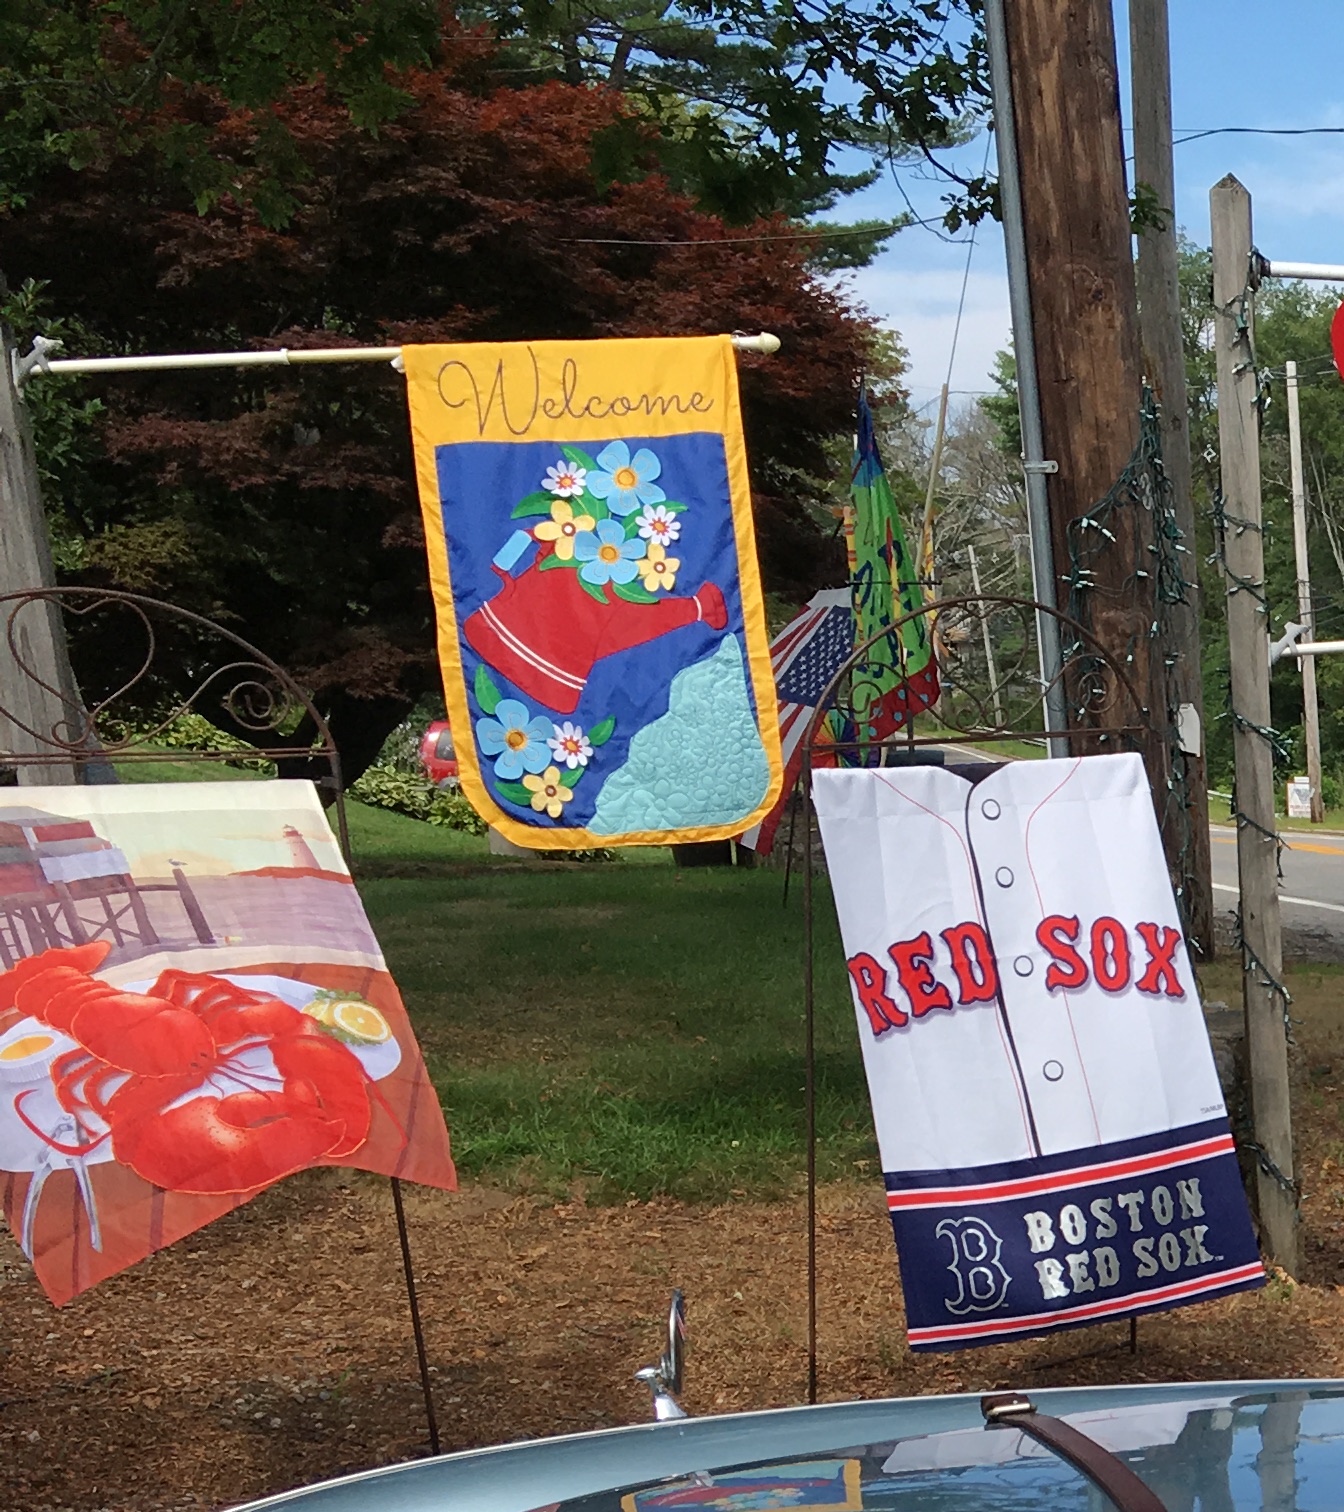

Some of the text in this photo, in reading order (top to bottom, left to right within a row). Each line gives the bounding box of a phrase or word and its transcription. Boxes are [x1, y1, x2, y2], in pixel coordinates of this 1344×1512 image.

[437, 345, 714, 436] Welcome
[848, 914, 1185, 1036] RED SOX
[1023, 1177, 1206, 1253] BOSTON
[935, 1216, 1012, 1315] B
[1033, 1225, 1214, 1300] RED SOX
